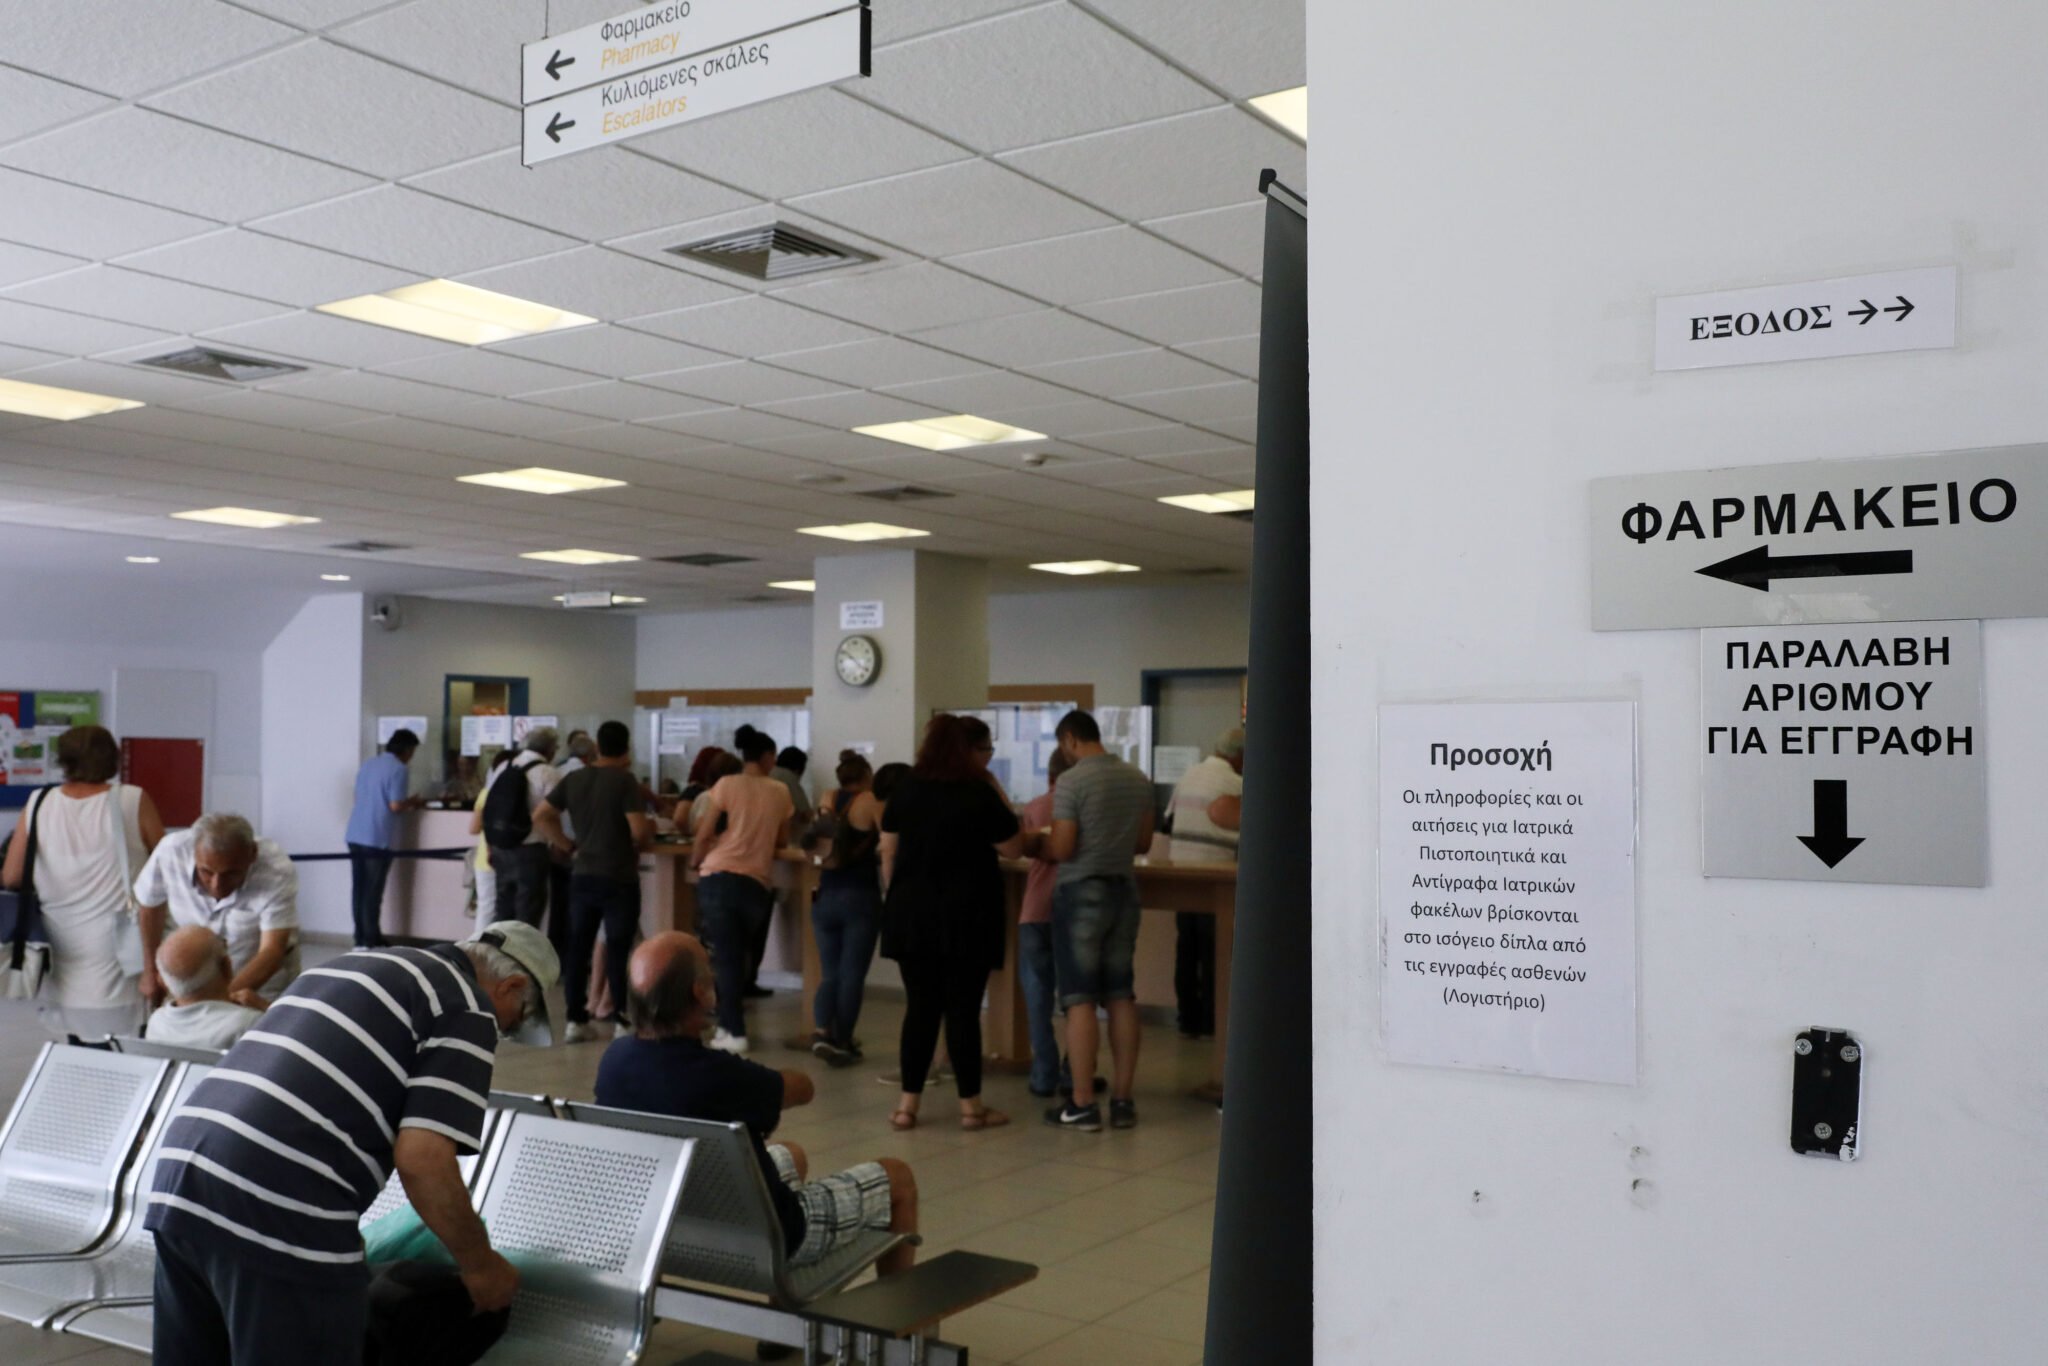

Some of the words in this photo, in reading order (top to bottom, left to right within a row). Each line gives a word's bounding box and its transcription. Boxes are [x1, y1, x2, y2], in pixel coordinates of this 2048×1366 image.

[601, 0, 690, 42] Φαρμακείο
[601, 31, 680, 70] Pharmacy
[602, 66, 697, 107] Κυλιόμενες
[703, 43, 769, 77] σκάλες
[602, 96, 687, 134] Escalators
[1689, 304, 1833, 341] ΕΞΟΔΟΣ
[1621, 478, 2017, 545] ΦΑΡΜΑΚΕΙΟ
[1726, 636, 1950, 670] ΠΑΡΑΛΑΒΗ
[1741, 681, 1933, 712] ΑΡΙΘΜΟΥ
[1430, 739, 1552, 772] Προσοχή
[1709, 726, 1768, 755] ΓΙΑ
[1781, 725, 1973, 757] ΕΓΓΡΑΦΗ
[1402, 789, 1422, 805] Οι
[1424, 788, 1532, 809] πληροφορίες
[1536, 793, 1563, 806] και
[1566, 794, 1584, 806] οι
[1411, 817, 1479, 837] αιτήσεις
[1481, 821, 1509, 837] για
[1513, 818, 1574, 838] Ιατρικά
[1419, 845, 1537, 866] Πιστοποιητικά
[1540, 852, 1568, 865] και
[1411, 872, 1499, 894] Αντίγραφα
[1503, 876, 1576, 896] Ιατρικών
[1410, 900, 1483, 920] φακέλων
[1487, 903, 1580, 924] βρίσκονται
[1403, 932, 1432, 946] στο
[1436, 931, 1495, 951] ισόγειο
[1499, 933, 1549, 952] δίπλα
[1552, 936, 1587, 954] από
[1403, 960, 1426, 976] τις
[1429, 960, 1507, 981] εγγραφές
[1511, 963, 1587, 983] ασθενών
[1442, 985, 1546, 1013] (Λογιστήριο)
